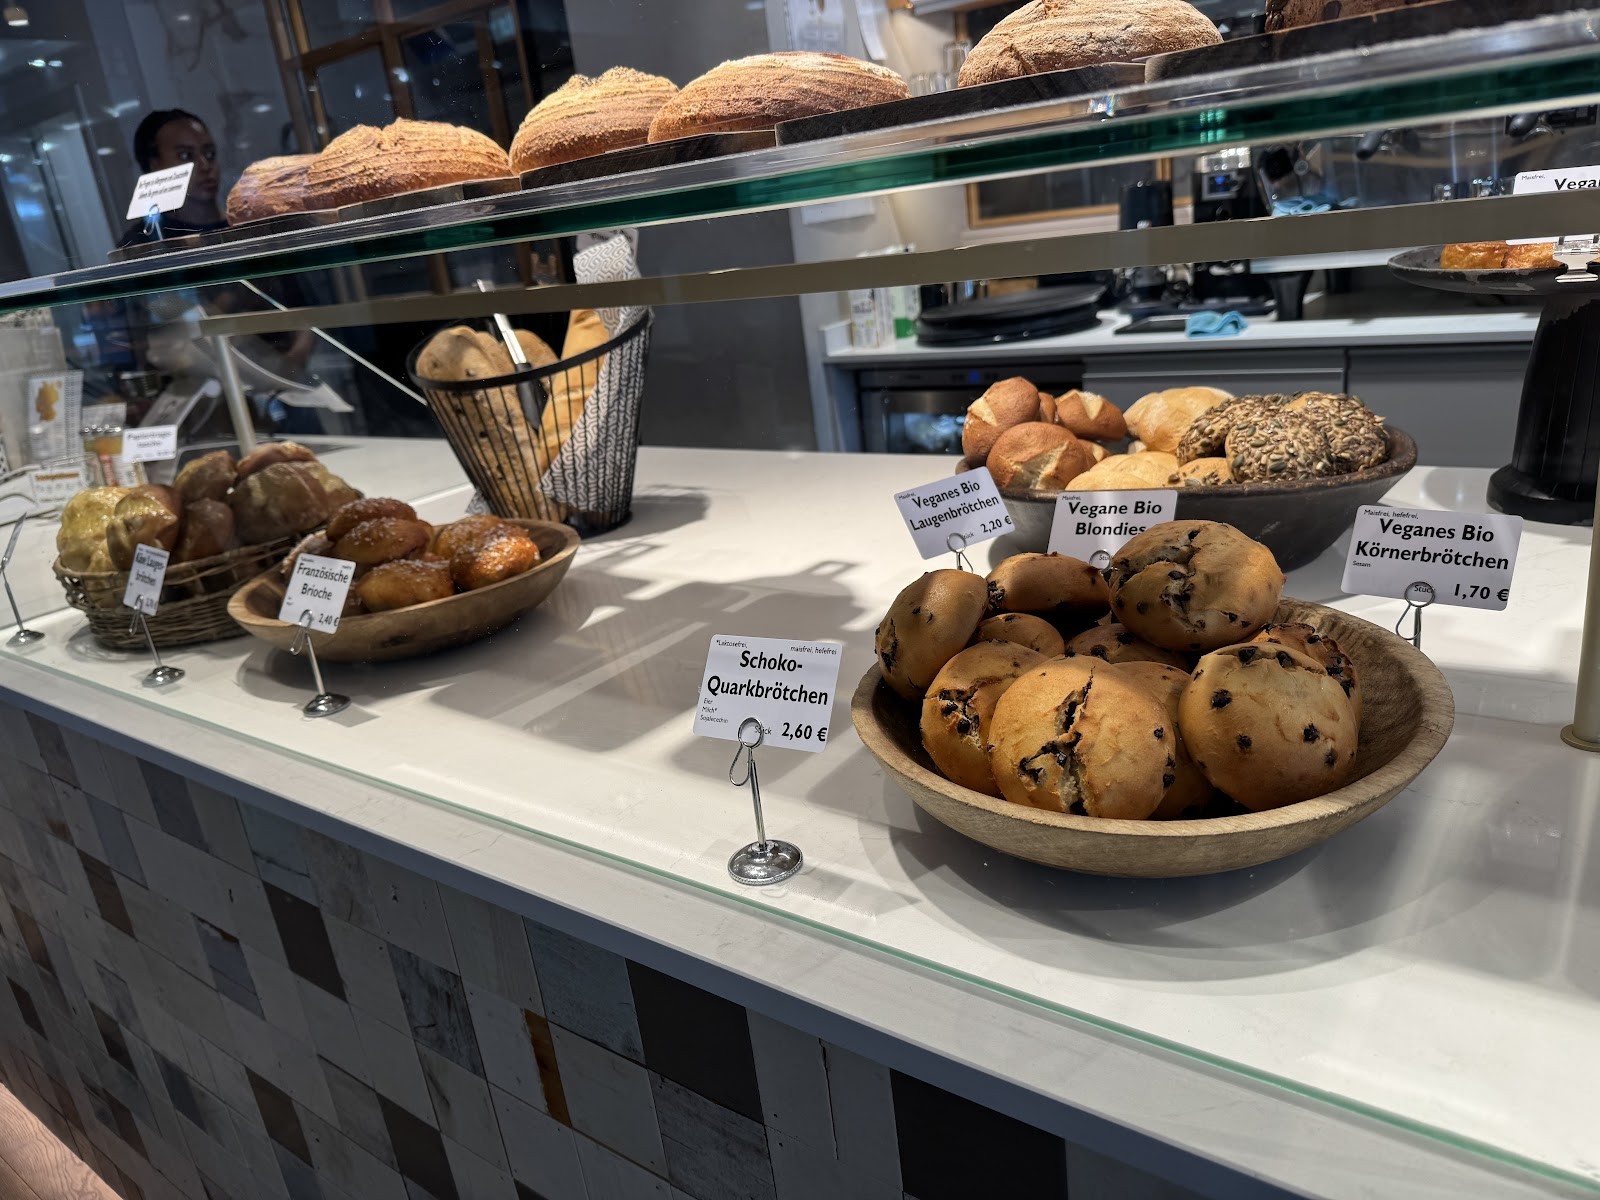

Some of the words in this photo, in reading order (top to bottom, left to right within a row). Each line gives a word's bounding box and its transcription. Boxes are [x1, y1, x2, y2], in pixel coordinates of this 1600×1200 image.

[1554, 177, 1600, 191] Vega
[912, 488, 960, 509] Veganes
[960, 481, 980, 494] Bio
[909, 496, 1000, 531] Laugenbrötchen
[1068, 501, 1128, 519] Vegane
[1134, 500, 1162, 514] Bio
[980, 518, 1002, 534] 2,20
[1004, 515, 1012, 525] €
[1075, 522, 1146, 536] Blondies
[1379, 517, 1456, 540] Veganes
[1462, 524, 1495, 543] Bio
[1355, 540, 1509, 570] Körnerbrötchen
[296, 562, 349, 584] Französische
[301, 583, 333, 600] Brioche
[1454, 583, 1490, 600] 1,70
[1496, 588, 1509, 602] €
[318, 613, 333, 626] 2,40
[333, 616, 340, 627] €
[739, 650, 803, 672] Schoko-
[707, 675, 829, 706] Quarkbrötchen
[781, 722, 813, 741] 2,60
[817, 727, 828, 742] €
